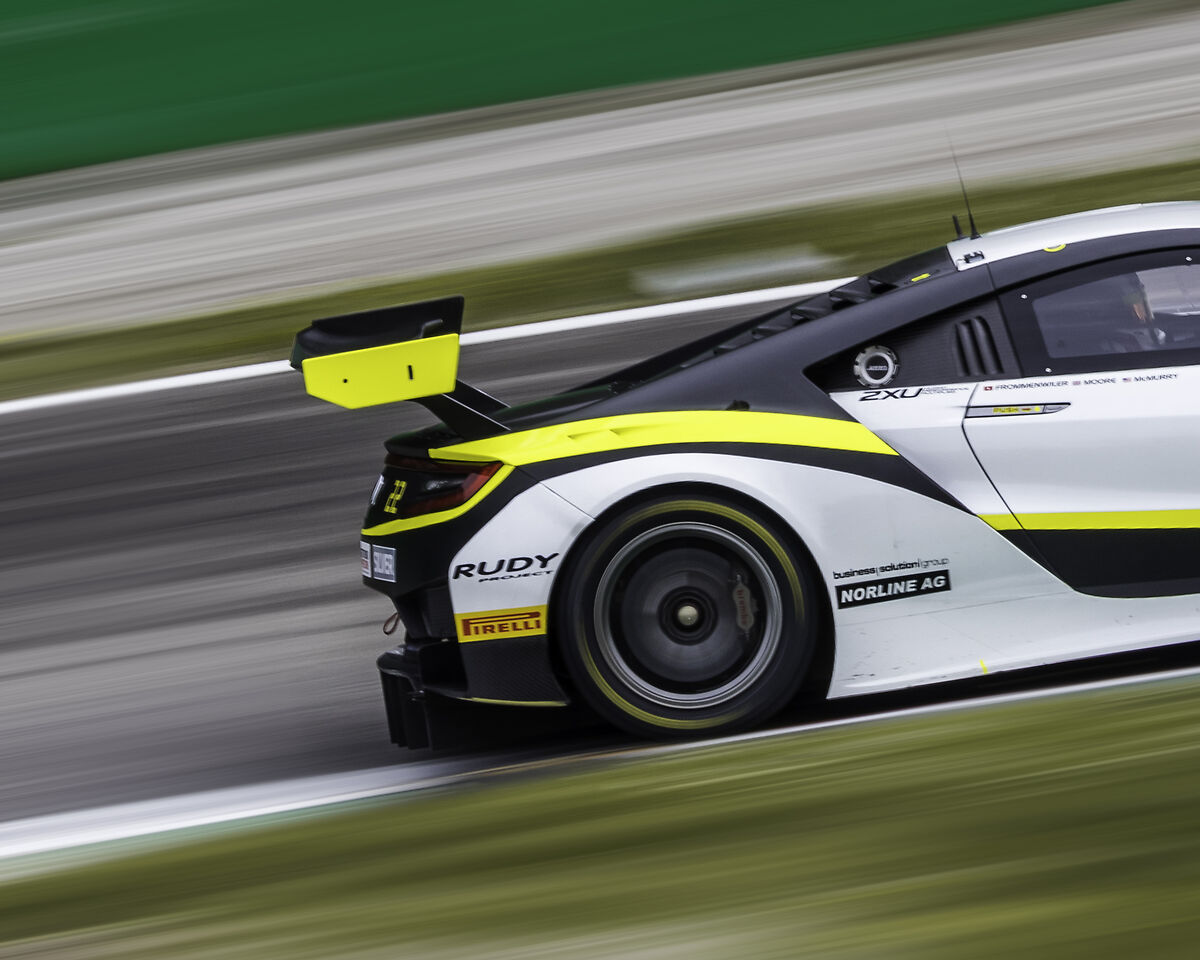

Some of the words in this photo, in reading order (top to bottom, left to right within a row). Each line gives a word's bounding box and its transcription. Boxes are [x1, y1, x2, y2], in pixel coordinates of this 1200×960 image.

[858, 387, 923, 401] 2XU
[1083, 377, 1117, 386] MOORE
[383, 479, 407, 514] 22
[452, 552, 560, 580] RUDY
[478, 570, 554, 583] PROJECT
[841, 579, 918, 603] NORLINE
[920, 575, 947, 590] AG
[461, 611, 542, 637] PIRELLI
